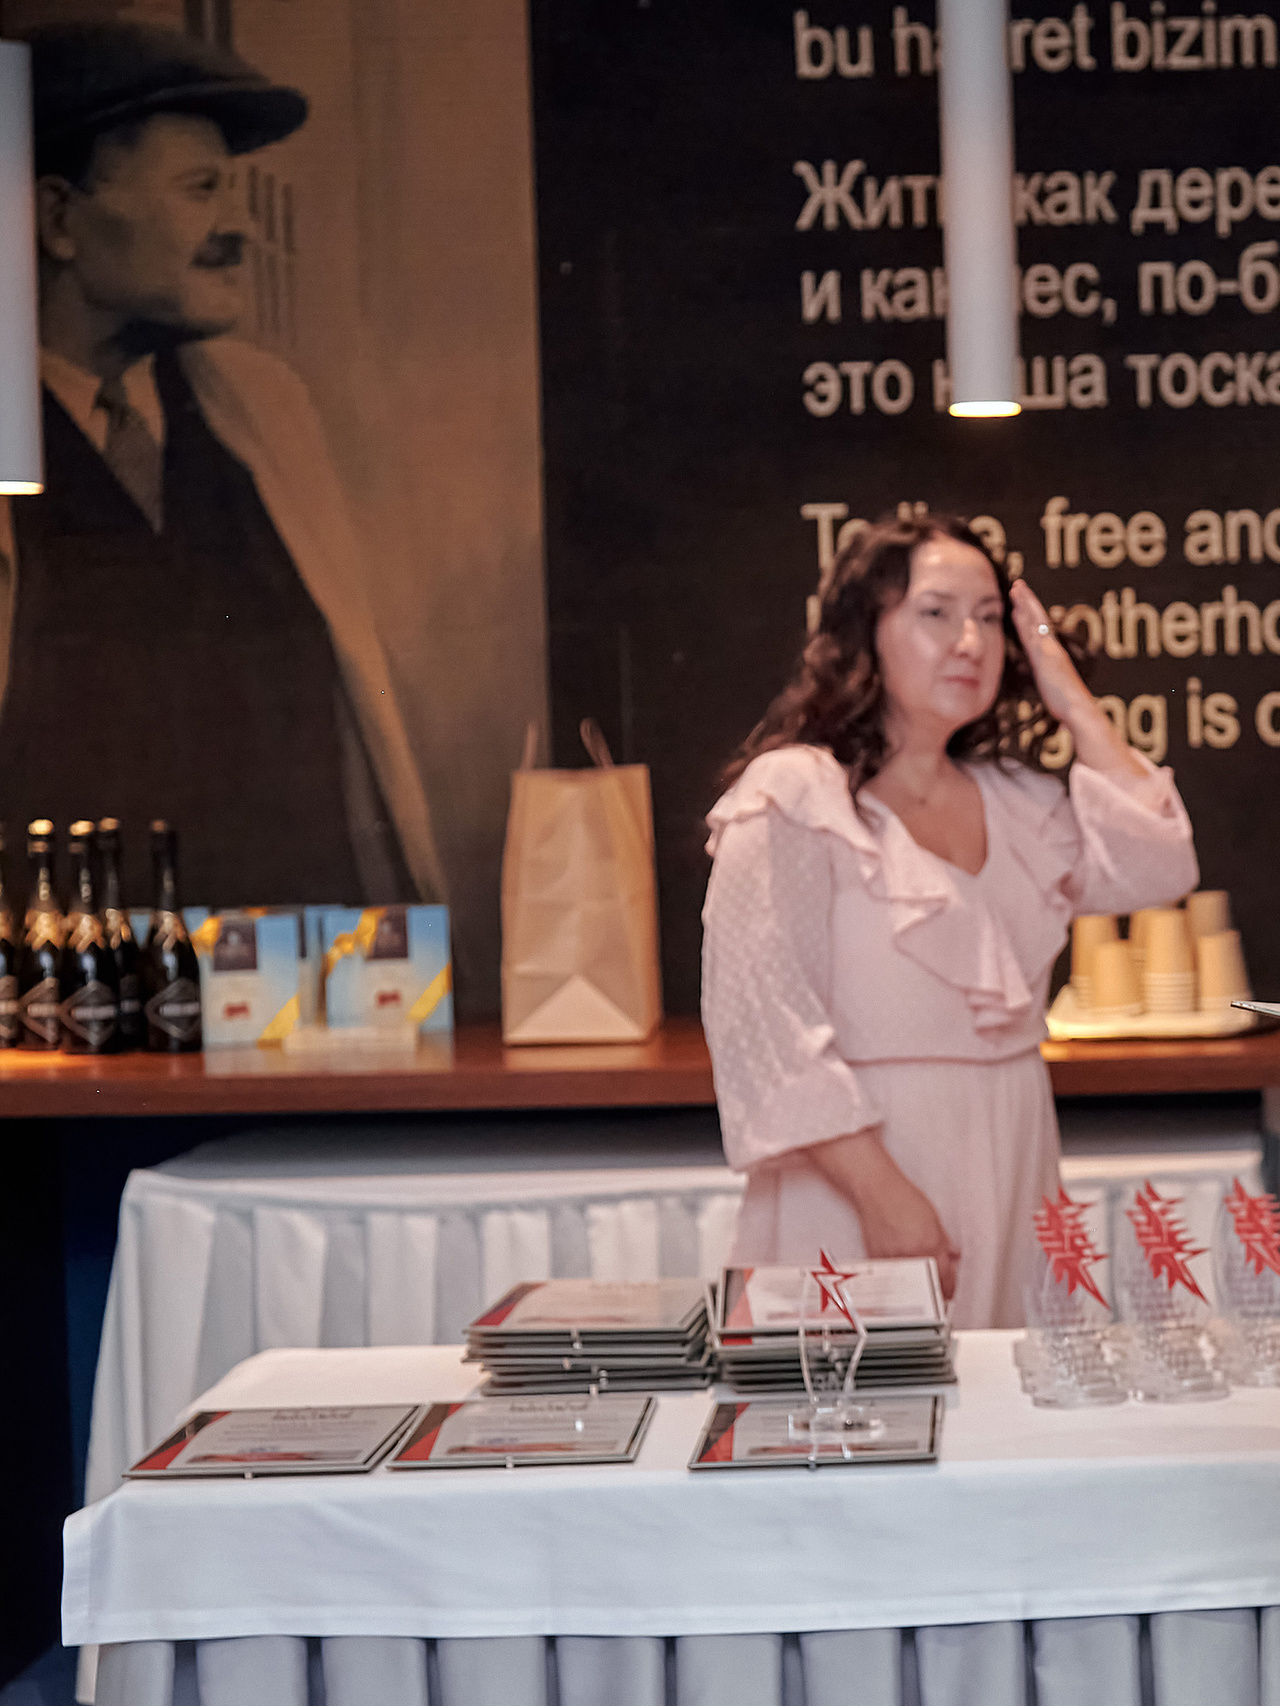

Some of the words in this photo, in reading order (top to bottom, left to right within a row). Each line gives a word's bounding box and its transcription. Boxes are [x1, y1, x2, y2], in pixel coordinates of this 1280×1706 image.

[794, 9, 875, 80] bu
[892, 4, 1097, 77] hret
[793, 159, 947, 230] Жит
[1012, 169, 1118, 226] как
[801, 270, 842, 323] и
[1012, 261, 1118, 327] ес,
[802, 359, 915, 417] это
[1040, 496, 1166, 569] free
[1186, 676, 1241, 749] is
